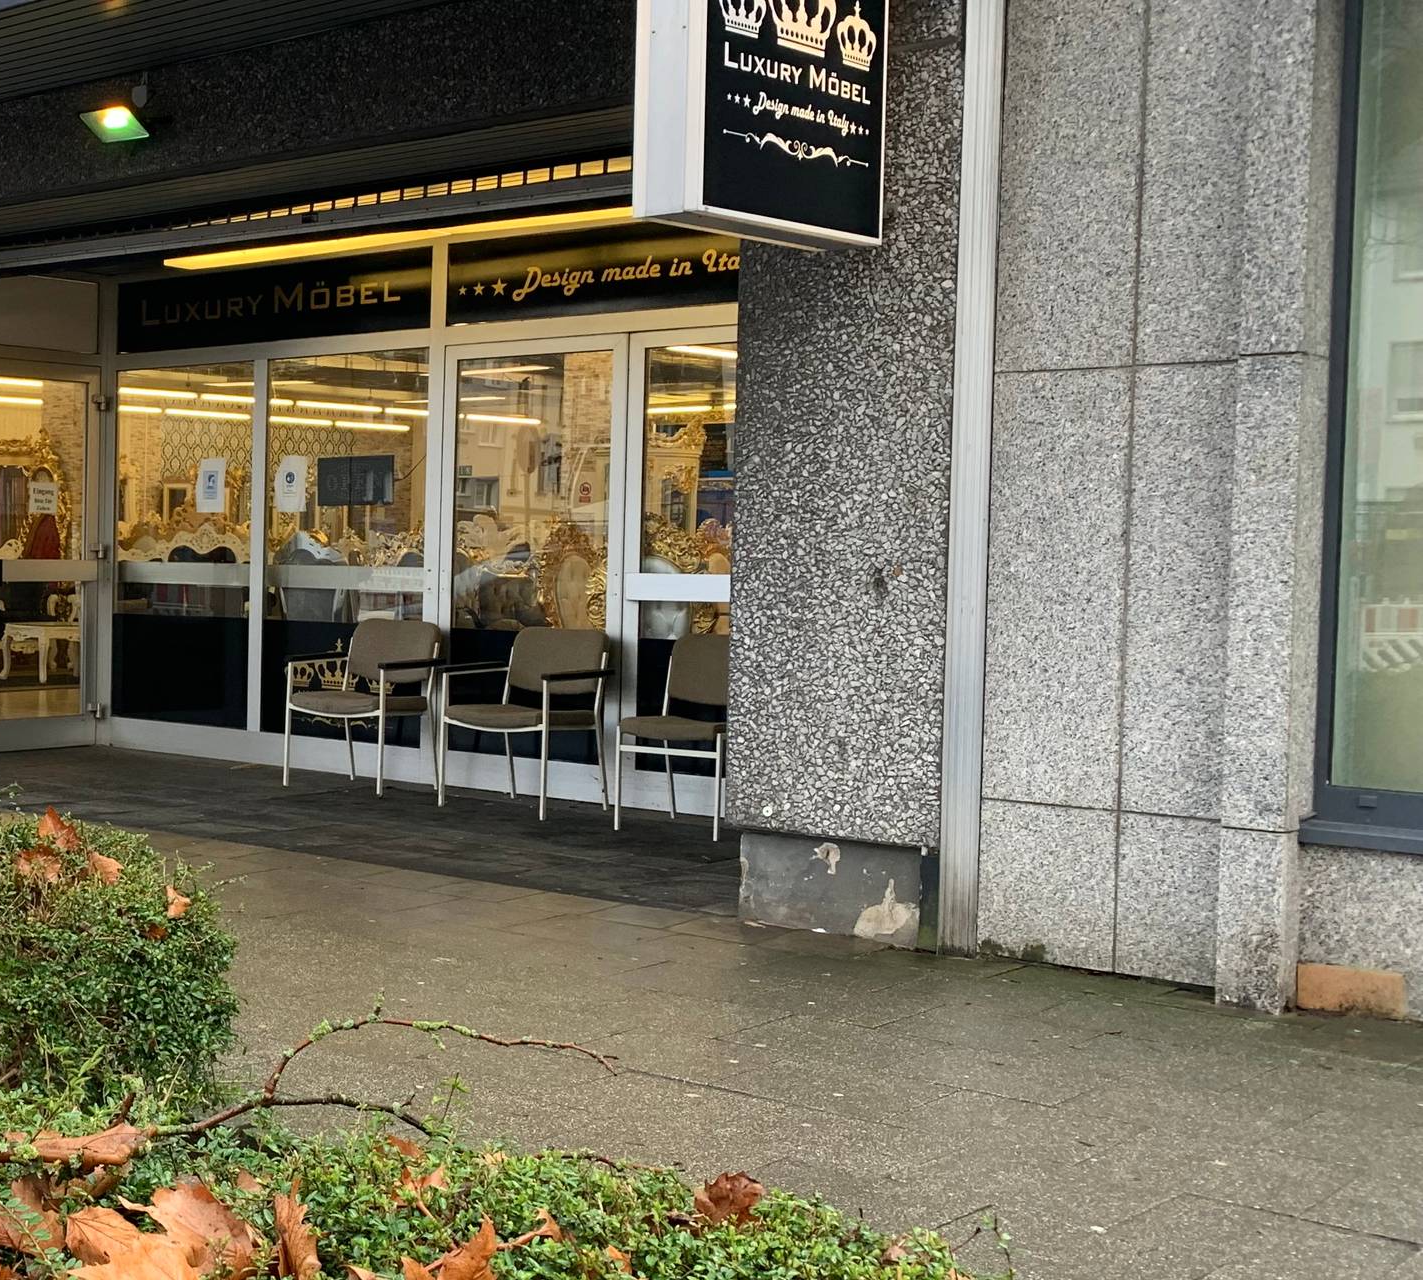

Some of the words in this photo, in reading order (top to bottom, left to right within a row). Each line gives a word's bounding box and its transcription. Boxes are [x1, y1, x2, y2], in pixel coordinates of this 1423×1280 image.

[724, 41, 803, 85] LUXURY
[809, 65, 871, 105] MÖBEL
[752, 91, 790, 120] Design
[791, 104, 815, 121] made
[816, 109, 826, 124] in
[827, 109, 850, 137] Italy
[512, 266, 595, 301] Design
[601, 256, 661, 282] made
[669, 258, 692, 277] in
[702, 248, 740, 273] Ita
[141, 294, 264, 326] LUXURY
[274, 281, 401, 314] MÖBEL
